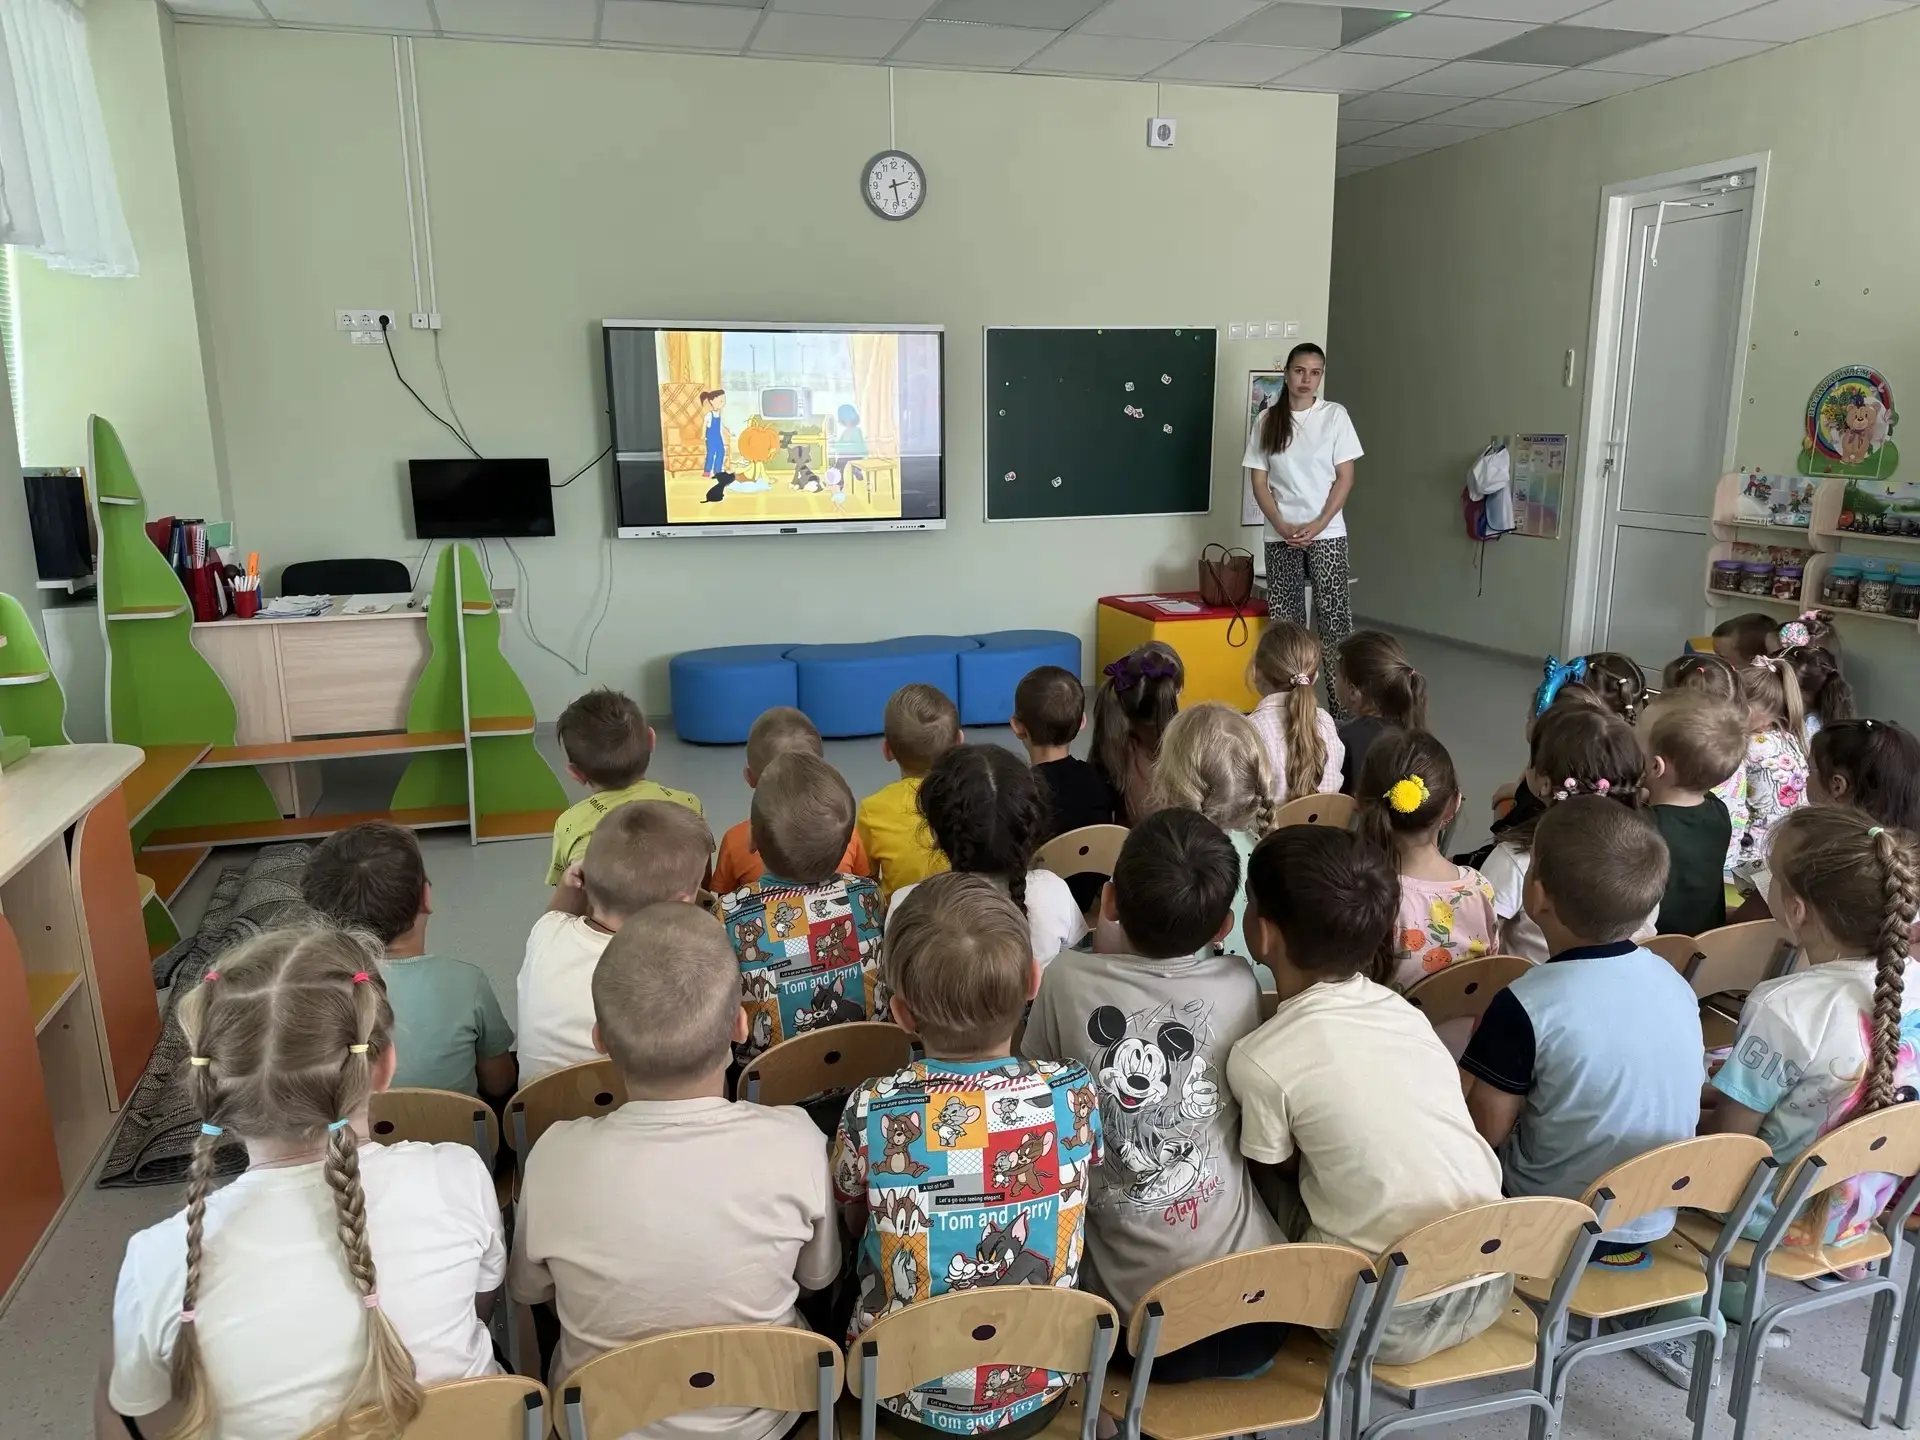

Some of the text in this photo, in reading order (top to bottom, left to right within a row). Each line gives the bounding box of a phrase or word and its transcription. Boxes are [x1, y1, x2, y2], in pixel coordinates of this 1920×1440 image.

[882, 164, 888, 172] 11
[890, 161, 898, 170] 12
[901, 164, 904, 172] 1
[874, 172, 882, 180] 10
[908, 172, 912, 180] 2
[873, 181, 878, 190] 9
[910, 182, 916, 190] 3
[876, 192, 880, 200] 8
[908, 192, 913, 200] 4
[883, 198, 888, 207] 7
[892, 202, 898, 210] 6
[902, 198, 906, 207] 5
[783, 982, 807, 995] Tom
[810, 974, 829, 988] and
[1164, 1176, 1219, 1229] Stay true
[938, 1200, 1052, 1231] Tom and Jerry
[930, 1412, 960, 1429] Tom
[966, 1412, 994, 1430] and
